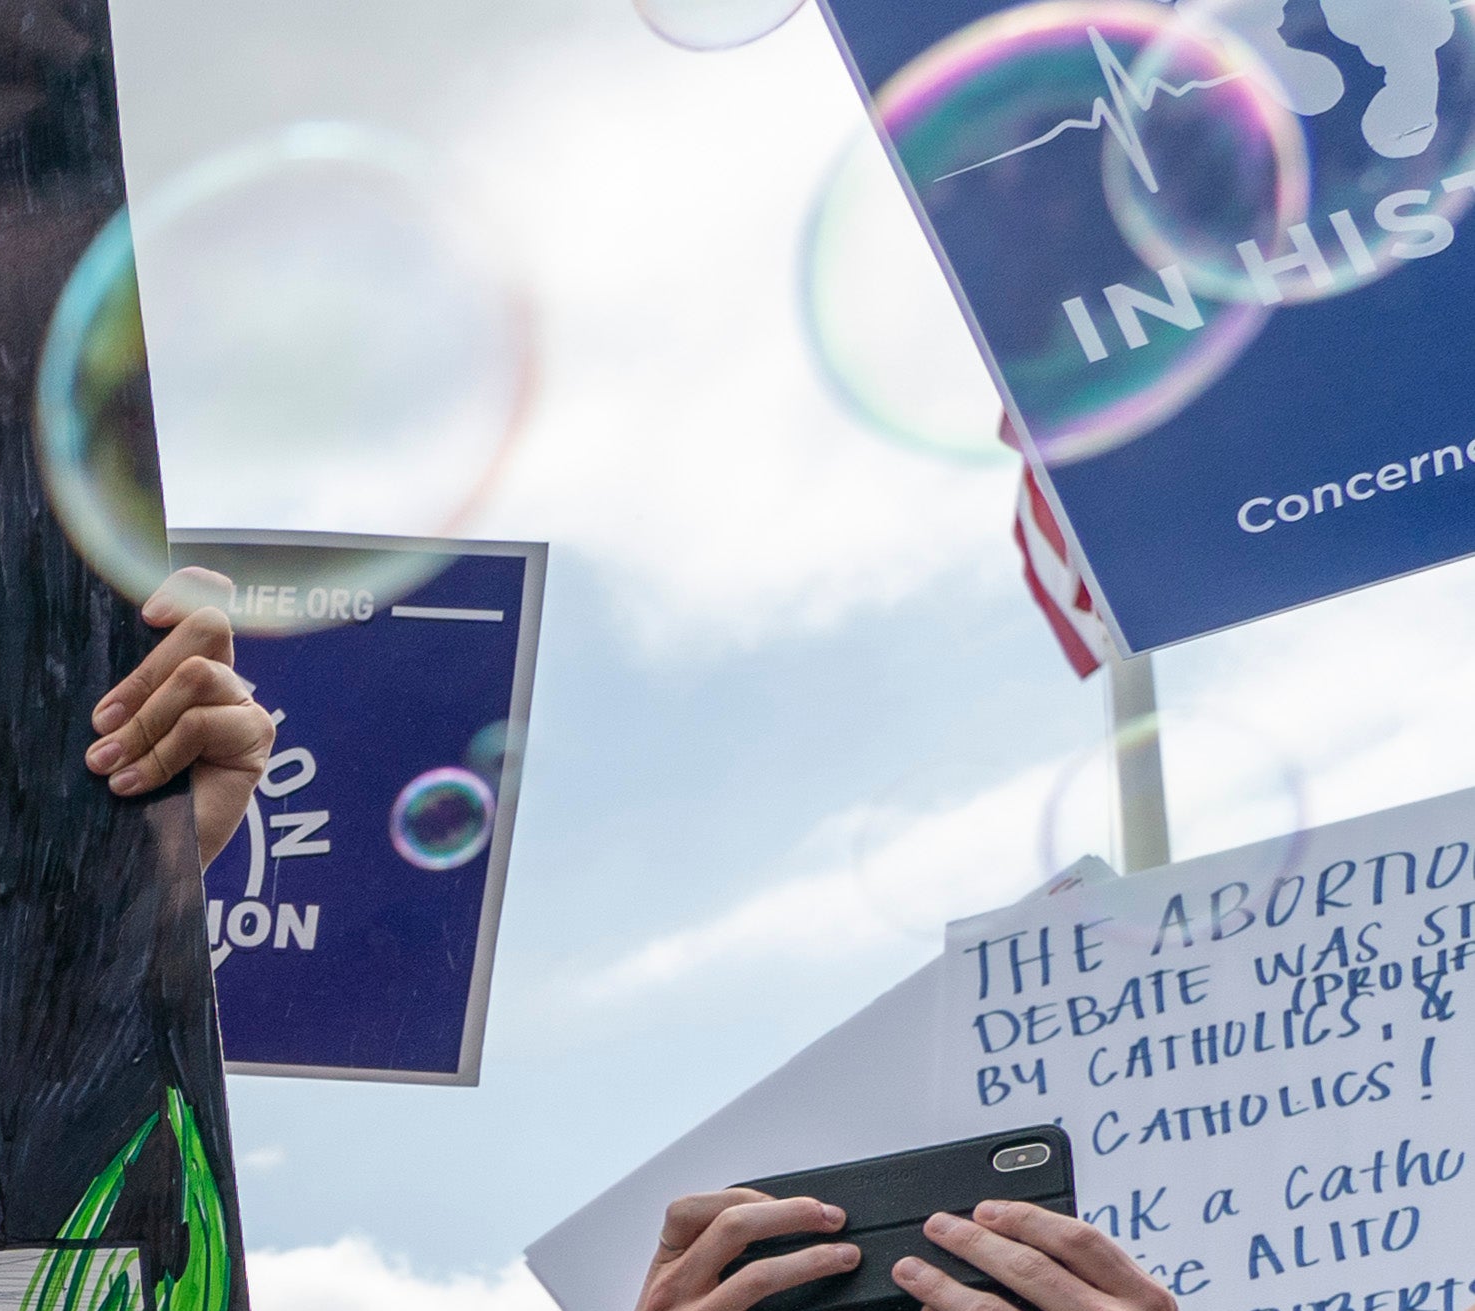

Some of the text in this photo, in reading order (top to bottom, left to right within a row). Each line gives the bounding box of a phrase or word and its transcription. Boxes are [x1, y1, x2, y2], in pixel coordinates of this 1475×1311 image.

[1062, 264, 1205, 363] IN
[963, 841, 1475, 1000] THE ABORTIO
[972, 964, 1211, 1054] DEBATE
[1254, 921, 1383, 987] WAS
[977, 1058, 1047, 1106] BY
[1203, 1187, 1240, 1224] a
[1247, 1206, 1421, 1281] ALITO
